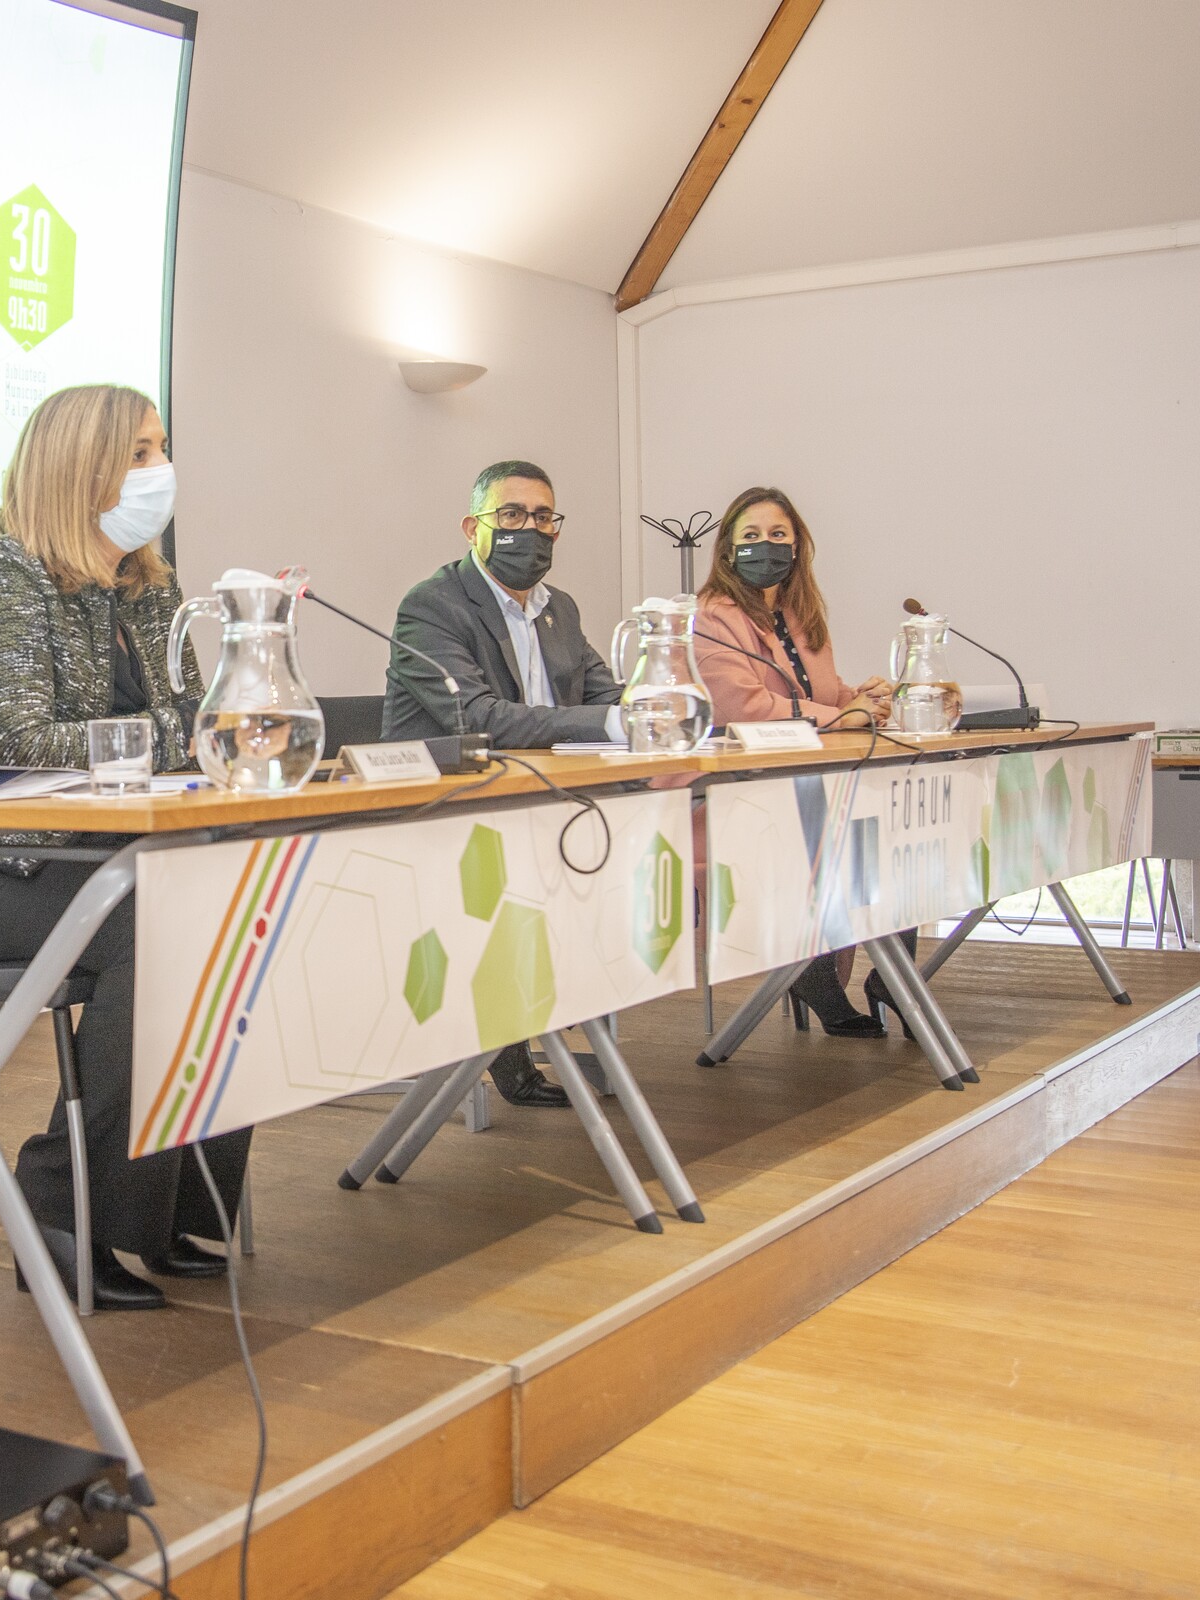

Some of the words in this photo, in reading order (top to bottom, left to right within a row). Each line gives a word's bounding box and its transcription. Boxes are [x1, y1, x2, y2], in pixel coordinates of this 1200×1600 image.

[9, 203, 50, 276] 30
[8, 296, 48, 333] 9h30
[891, 769, 951, 832] FÓRUM
[643, 850, 672, 933] 30
